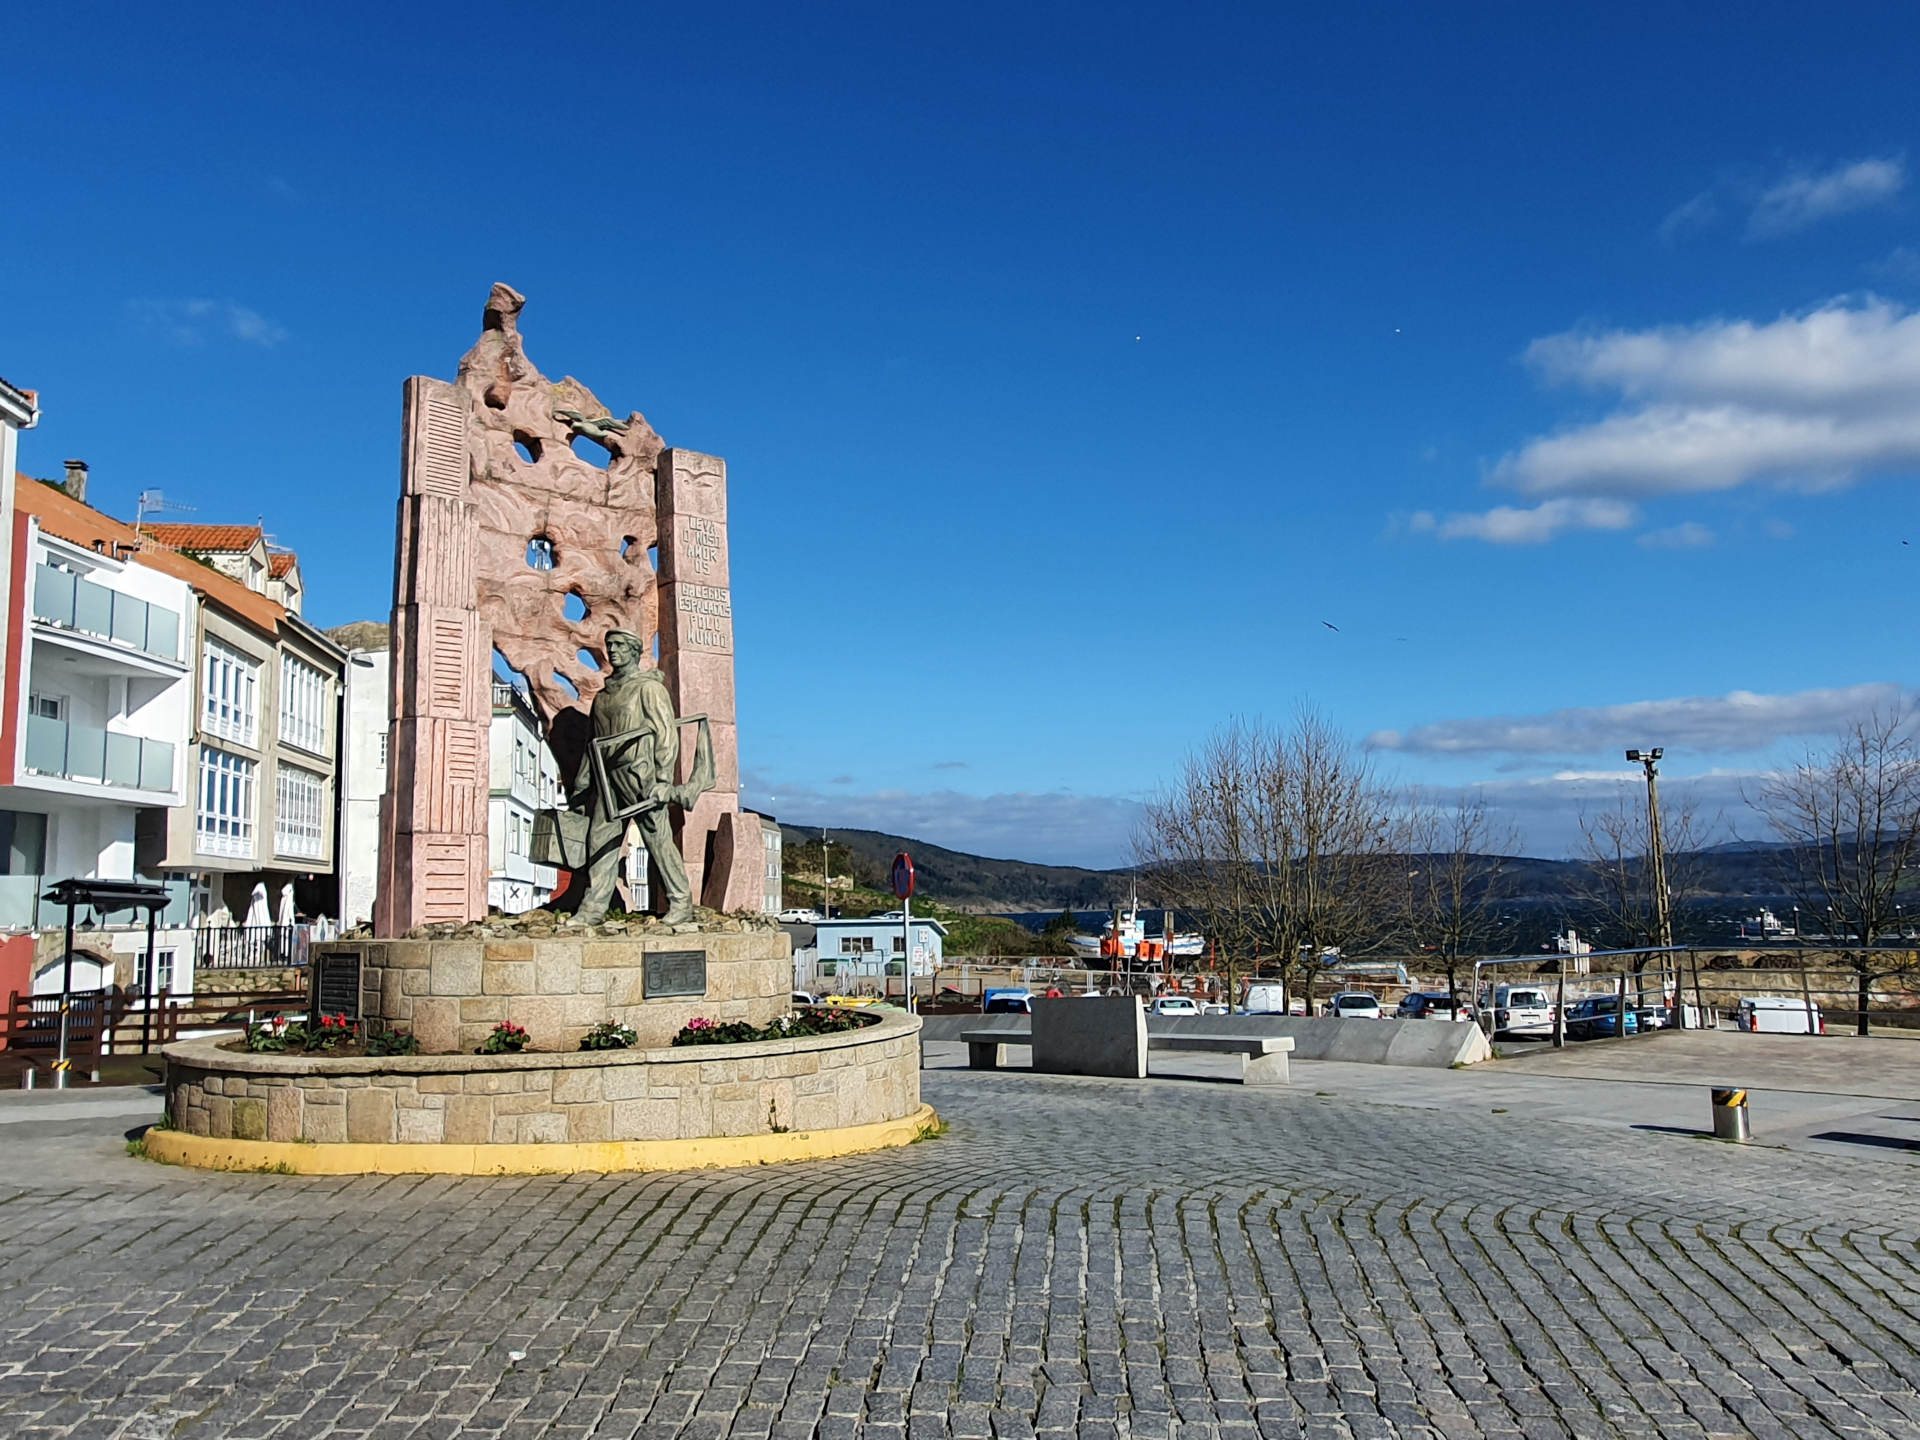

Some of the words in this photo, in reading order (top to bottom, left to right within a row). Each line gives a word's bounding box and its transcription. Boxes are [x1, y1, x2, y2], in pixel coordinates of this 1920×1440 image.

[689, 515, 716, 535] LEVA
[683, 529, 690, 543] O
[696, 531, 720, 549] NOSO
[687, 544, 717, 562] AMOR
[695, 561, 710, 575] OS
[682, 582, 727, 603] GALEGOS
[690, 615, 720, 632] POLO
[687, 629, 728, 648] MUNDO
